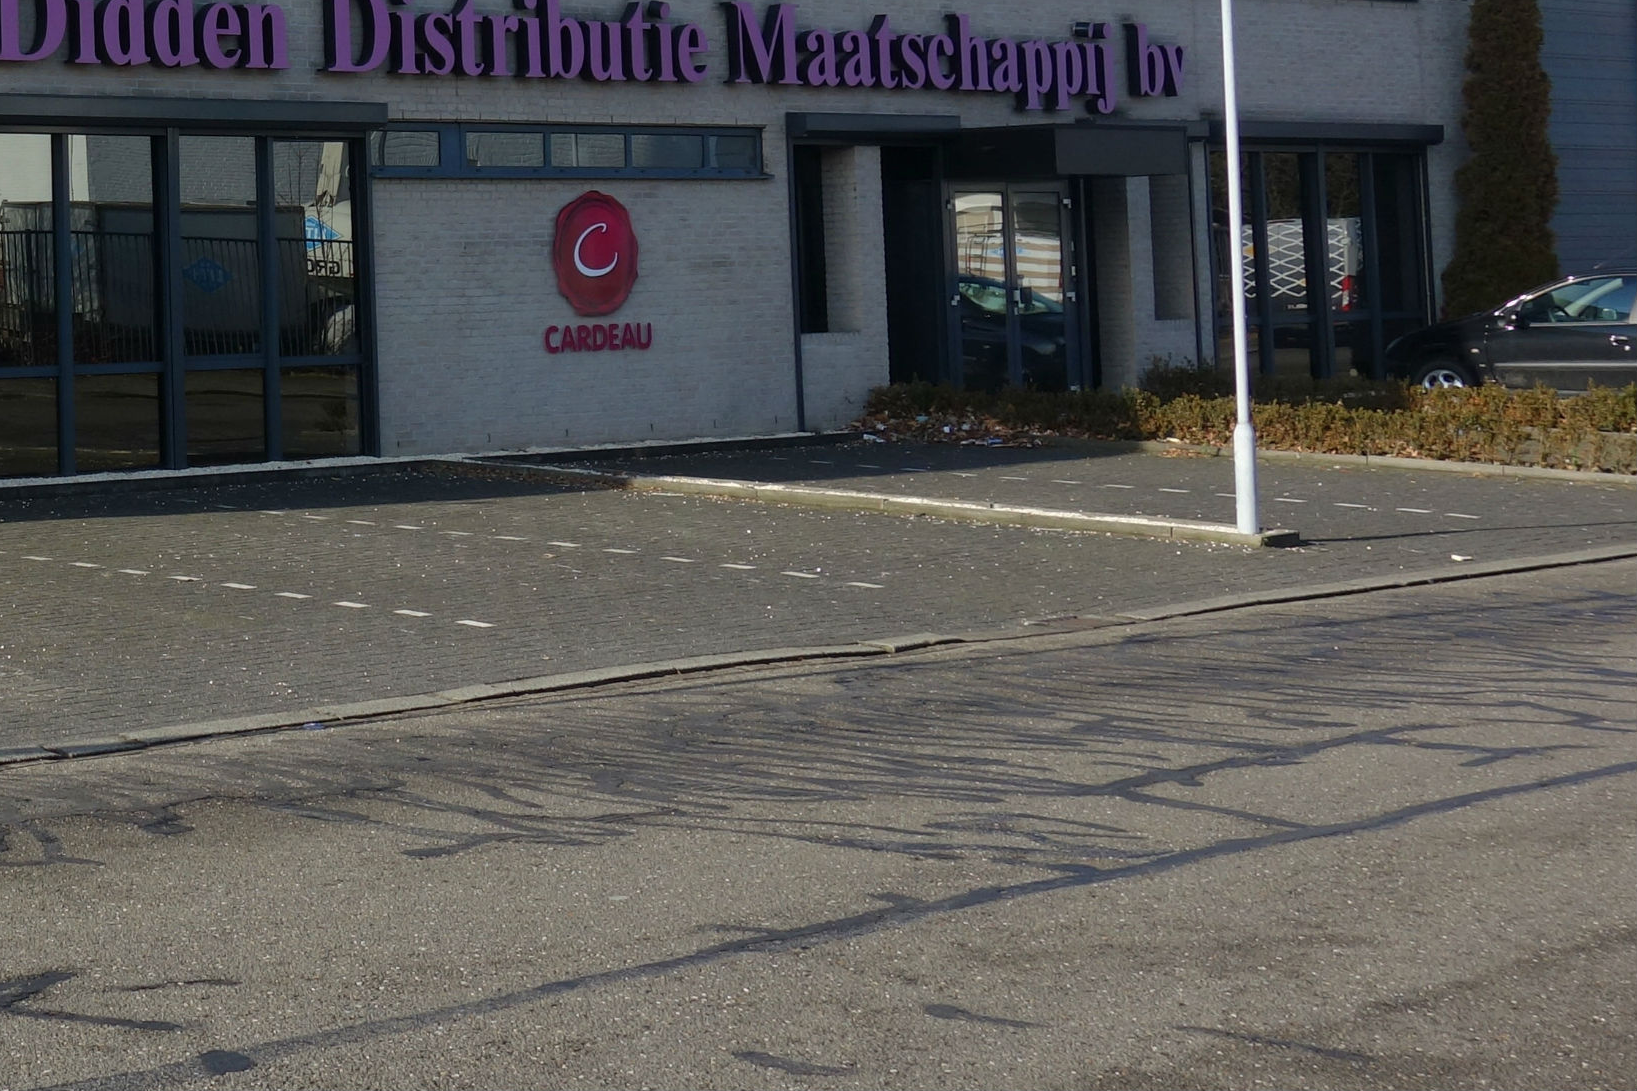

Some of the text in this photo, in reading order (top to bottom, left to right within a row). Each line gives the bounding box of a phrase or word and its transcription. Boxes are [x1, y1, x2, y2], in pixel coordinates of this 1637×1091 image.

[725, 1, 1116, 114] Maatschappij
[1126, 22, 1188, 98] bv
[544, 322, 653, 354] CARDEAU
